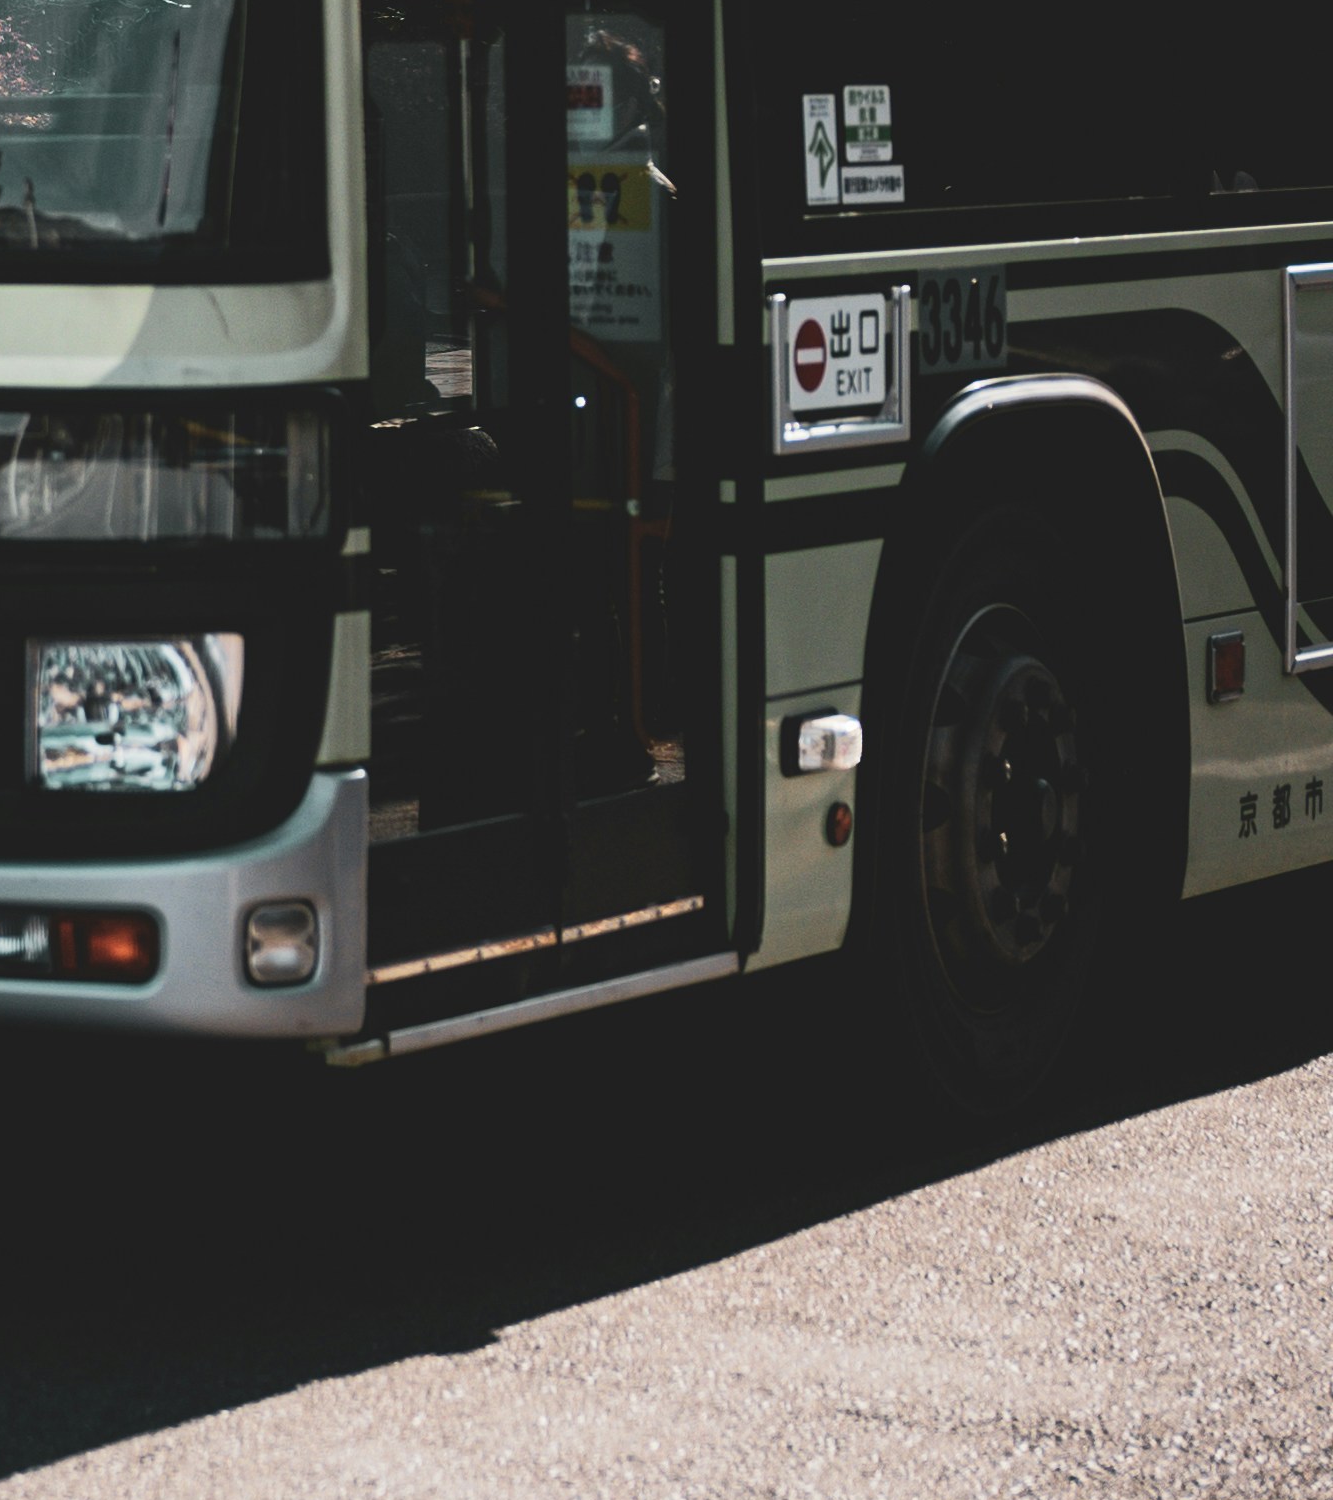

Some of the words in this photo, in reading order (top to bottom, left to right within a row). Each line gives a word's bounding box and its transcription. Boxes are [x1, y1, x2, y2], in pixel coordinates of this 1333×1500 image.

[830, 308, 880, 359] 出口
[921, 275, 1005, 367] 3346
[836, 367, 873, 396] EXIT
[1238, 775, 1323, 838] 京都市
